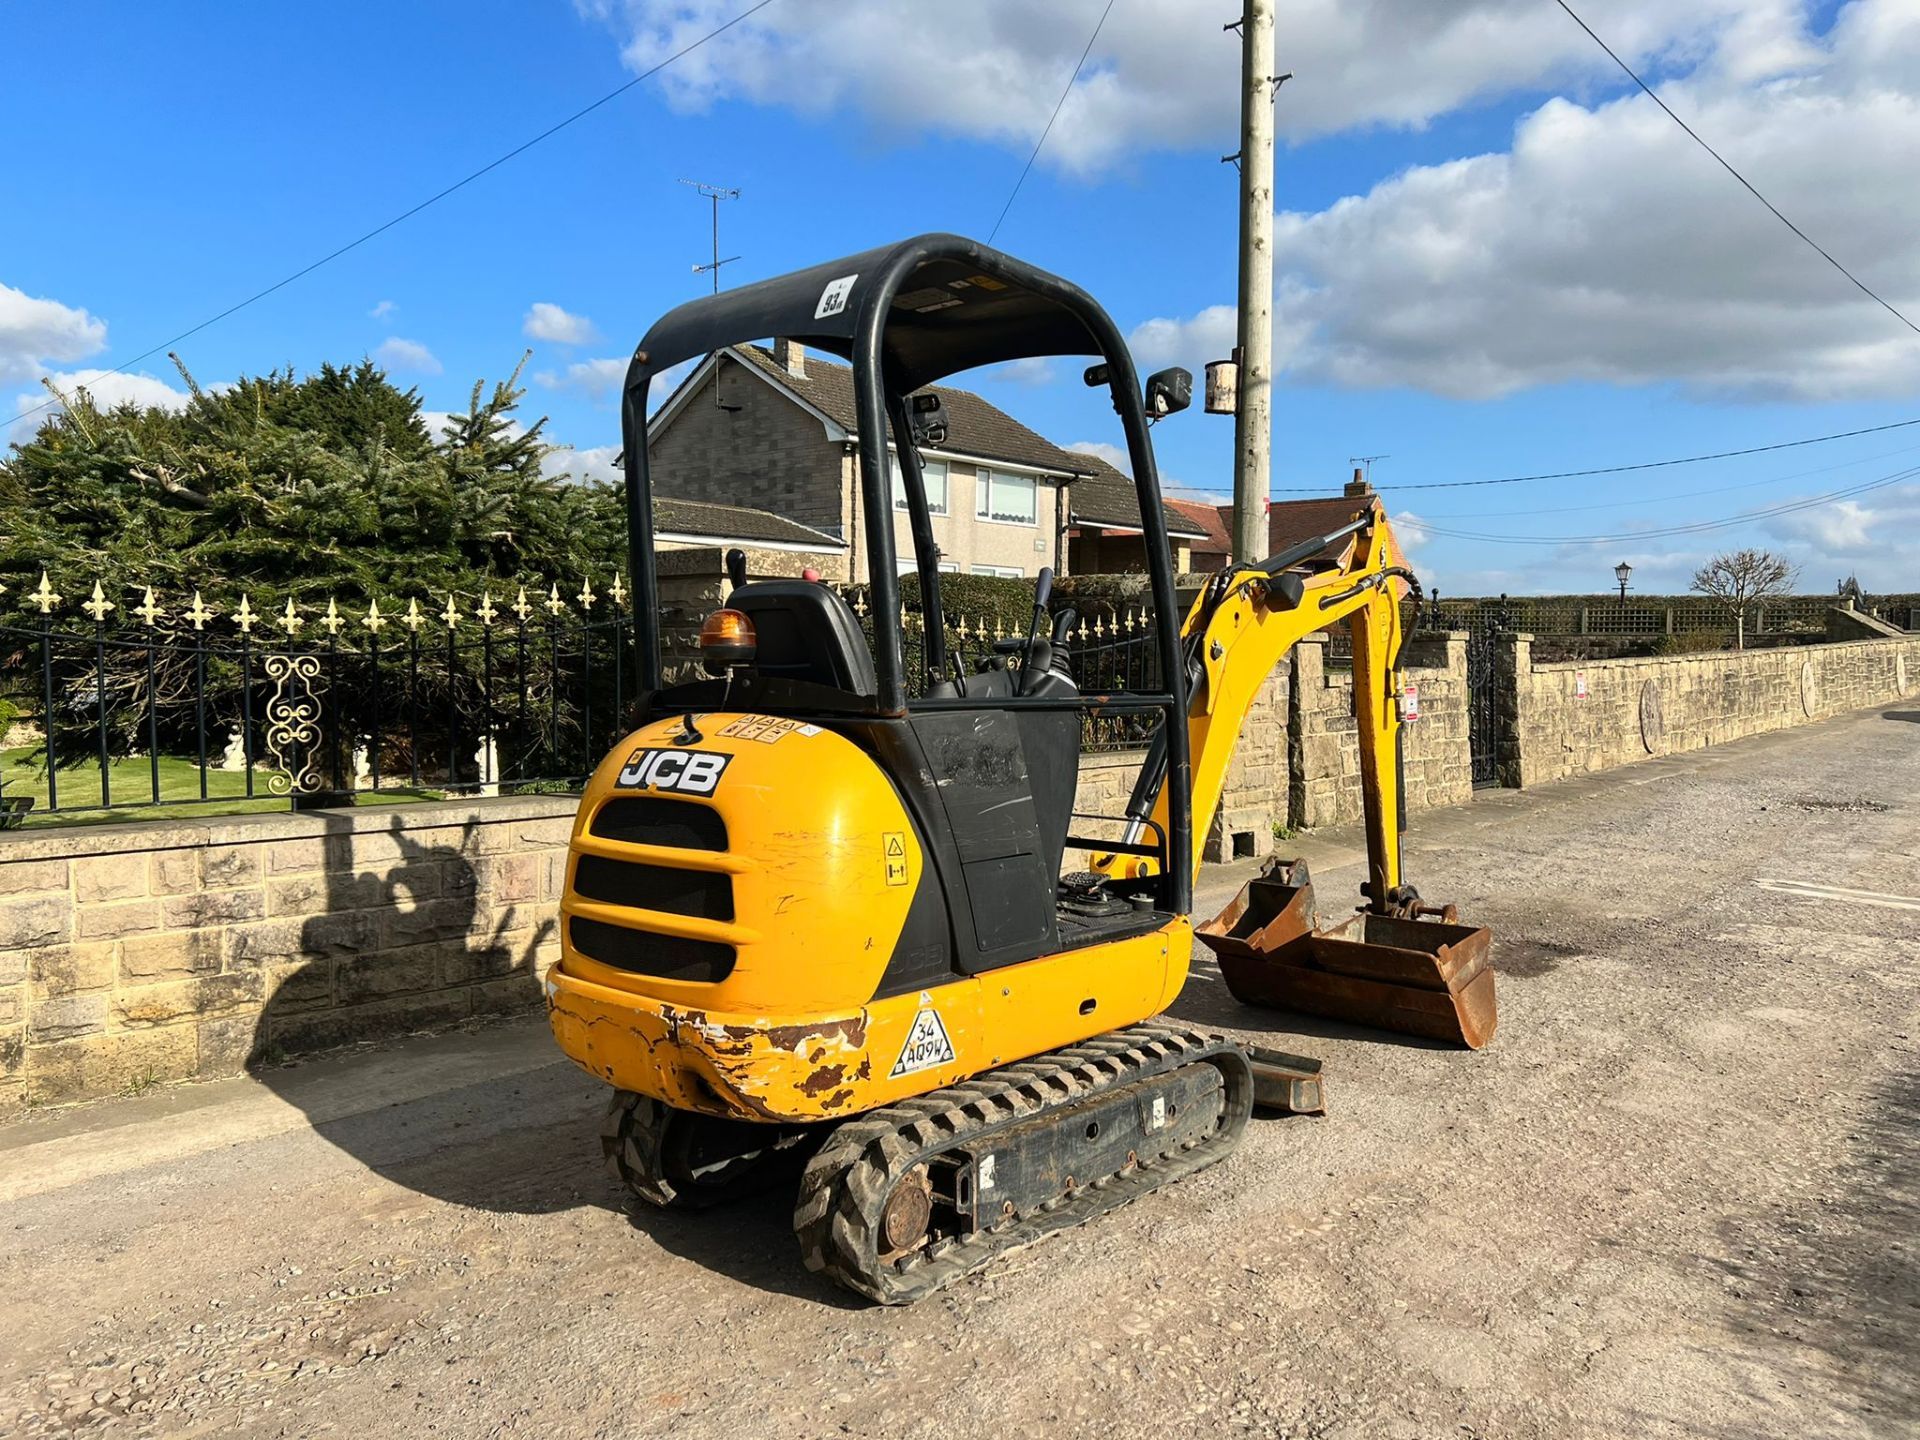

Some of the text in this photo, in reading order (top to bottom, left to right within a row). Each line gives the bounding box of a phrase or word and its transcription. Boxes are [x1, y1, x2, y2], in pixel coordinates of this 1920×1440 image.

[823, 292, 840, 313] 93
[619, 750, 726, 792] JCB
[917, 1020, 934, 1041] 34
[906, 1038, 943, 1064] AQ9W
